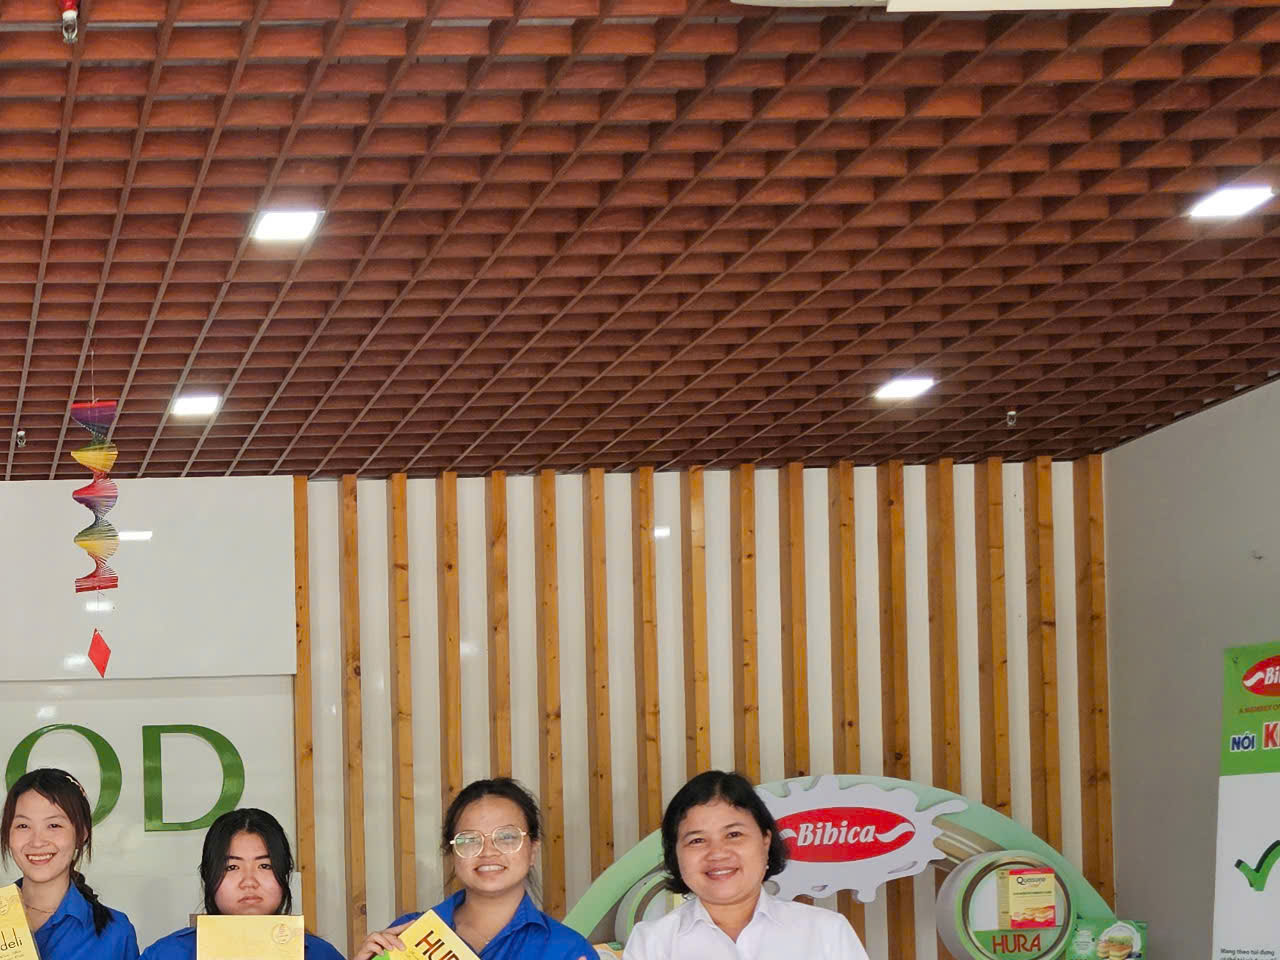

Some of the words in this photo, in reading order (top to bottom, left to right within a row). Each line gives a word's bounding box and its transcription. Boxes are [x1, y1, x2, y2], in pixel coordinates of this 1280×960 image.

[1264, 722, 1280, 750] K
[797, 820, 877, 847] Bibica
[0, 928, 23, 951] deli
[992, 933, 1041, 954] HURA
